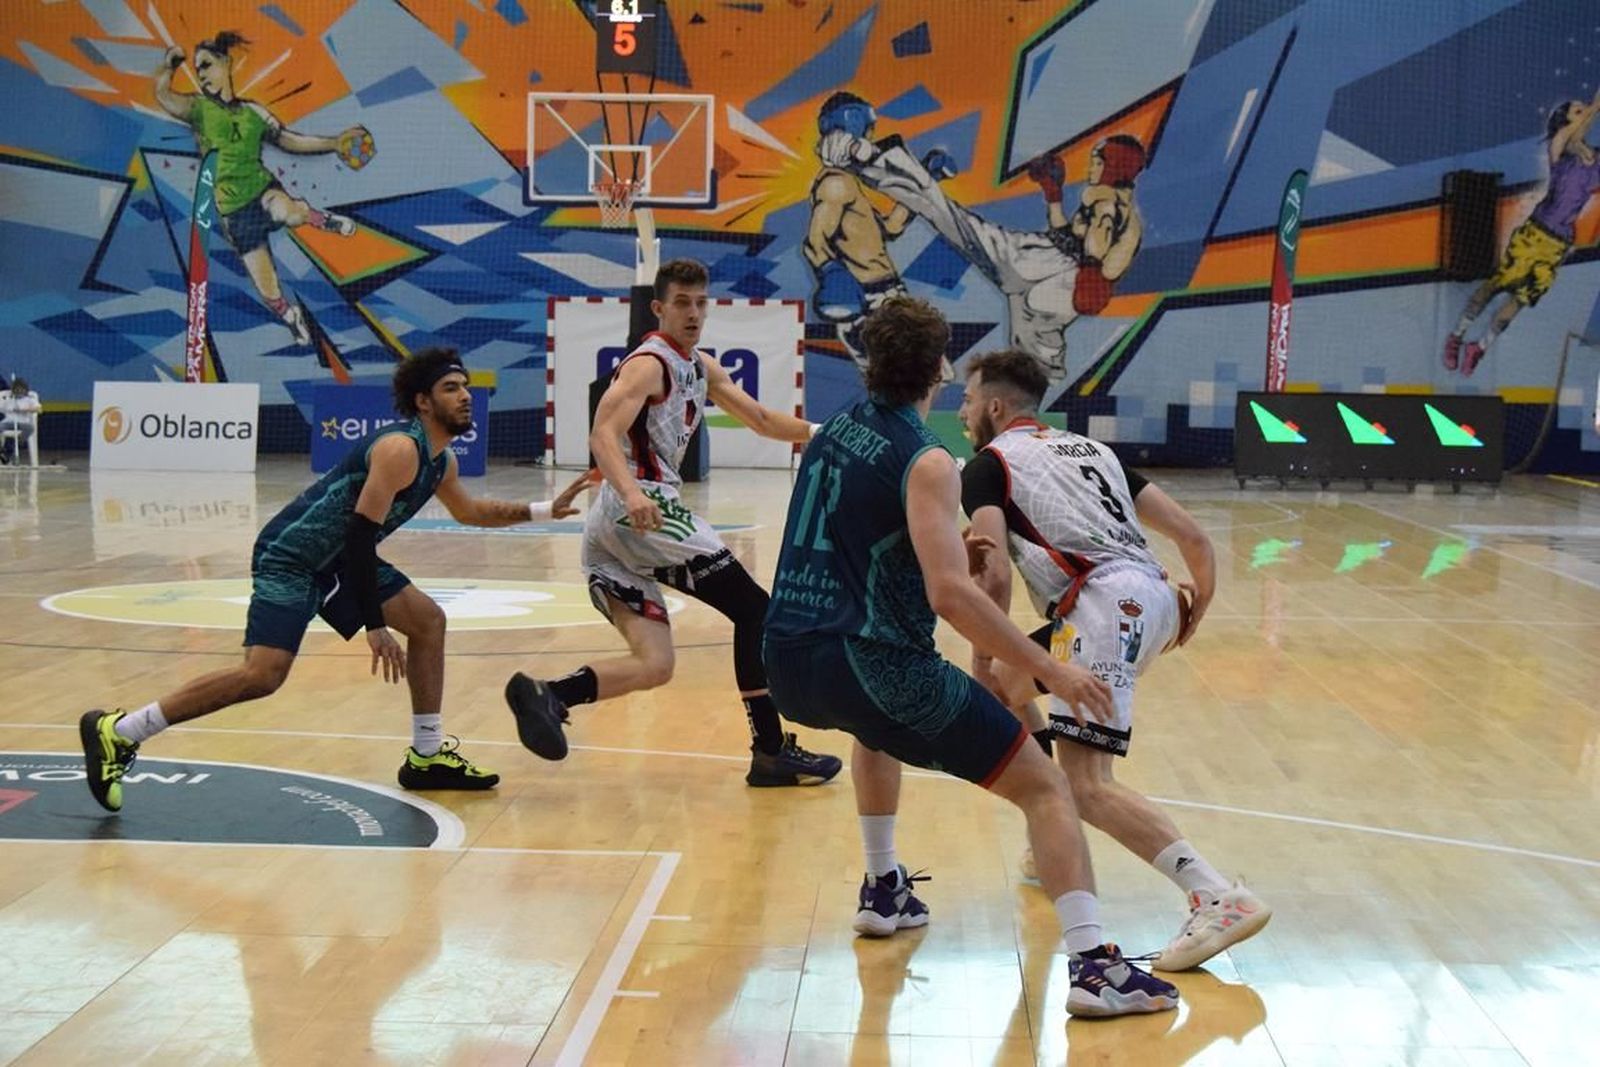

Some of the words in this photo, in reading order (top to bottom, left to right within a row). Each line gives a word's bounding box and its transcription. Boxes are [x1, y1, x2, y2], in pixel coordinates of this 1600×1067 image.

[613, 23, 637, 56] 5
[140, 414, 252, 439] Oblanca
[1079, 465, 1128, 523] 3
